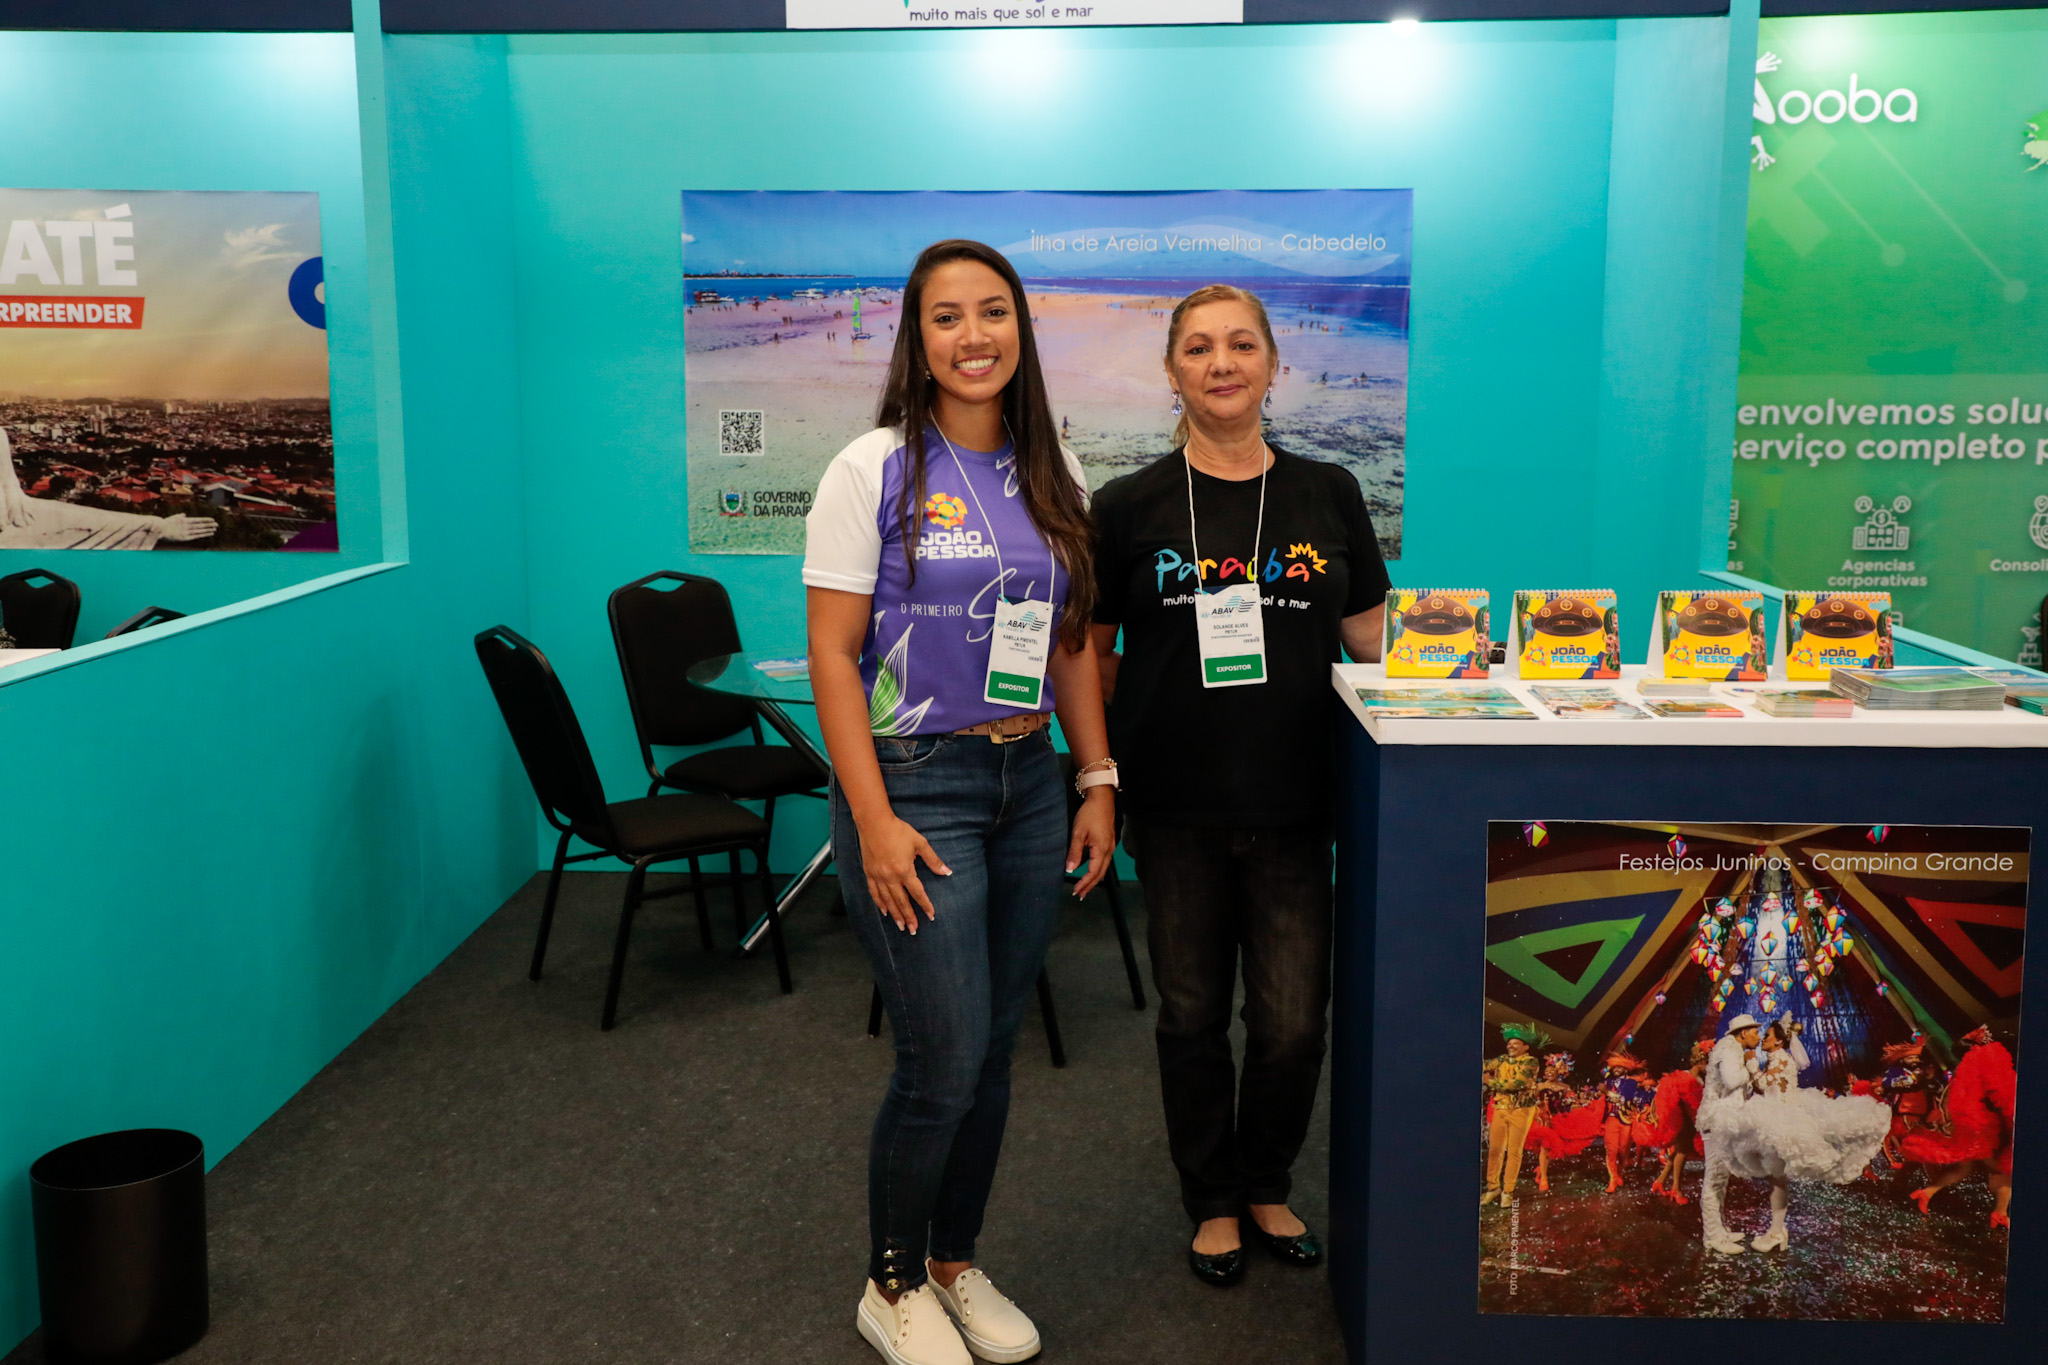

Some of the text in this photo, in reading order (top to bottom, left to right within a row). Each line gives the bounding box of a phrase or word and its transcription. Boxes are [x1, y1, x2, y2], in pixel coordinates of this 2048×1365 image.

[910, 5, 1093, 22] muito mais que sol e mar
[0, 203, 138, 287] ATÉ
[1072, 233, 1099, 251] de
[1105, 234, 1158, 251] Areia
[1165, 233, 1262, 251] Vermelha
[1281, 232, 1387, 251] Cabedelo
[1856, 432, 2026, 466] completo
[753, 491, 812, 503] GOVERNO
[754, 505, 770, 517] DA
[920, 527, 982, 546] JOÃO
[915, 544, 996, 560] PESSOA
[1827, 574, 1928, 589] corporativas
[1163, 594, 1195, 607] muito
[1277, 598, 1286, 608] e
[1289, 599, 1311, 610] mar
[901, 603, 962, 616] O PRIMEIRO
[1211, 606, 1234, 615] ABAV
[1007, 619, 1027, 629] ABAV
[1419, 643, 1455, 655] JOÃO
[1551, 644, 1586, 656] JOÃO
[1695, 644, 1731, 656] JOÃO
[1819, 646, 1857, 658] JOÃO
[1420, 654, 1468, 664] PESSOA
[1551, 655, 1598, 664] PESSOA
[1696, 655, 1744, 664] PESSOA
[1820, 657, 1871, 666] PESSOA
[1216, 664, 1252, 673] EXPOSITOR
[998, 682, 1029, 693] EXPOSITOR
[1620, 853, 1704, 875] Festejos
[1711, 853, 1792, 872] Juninos
[1812, 852, 1917, 875] Campina
[1925, 852, 2014, 872] Grande
[1511, 1198, 1520, 1238] PIMENTEL
